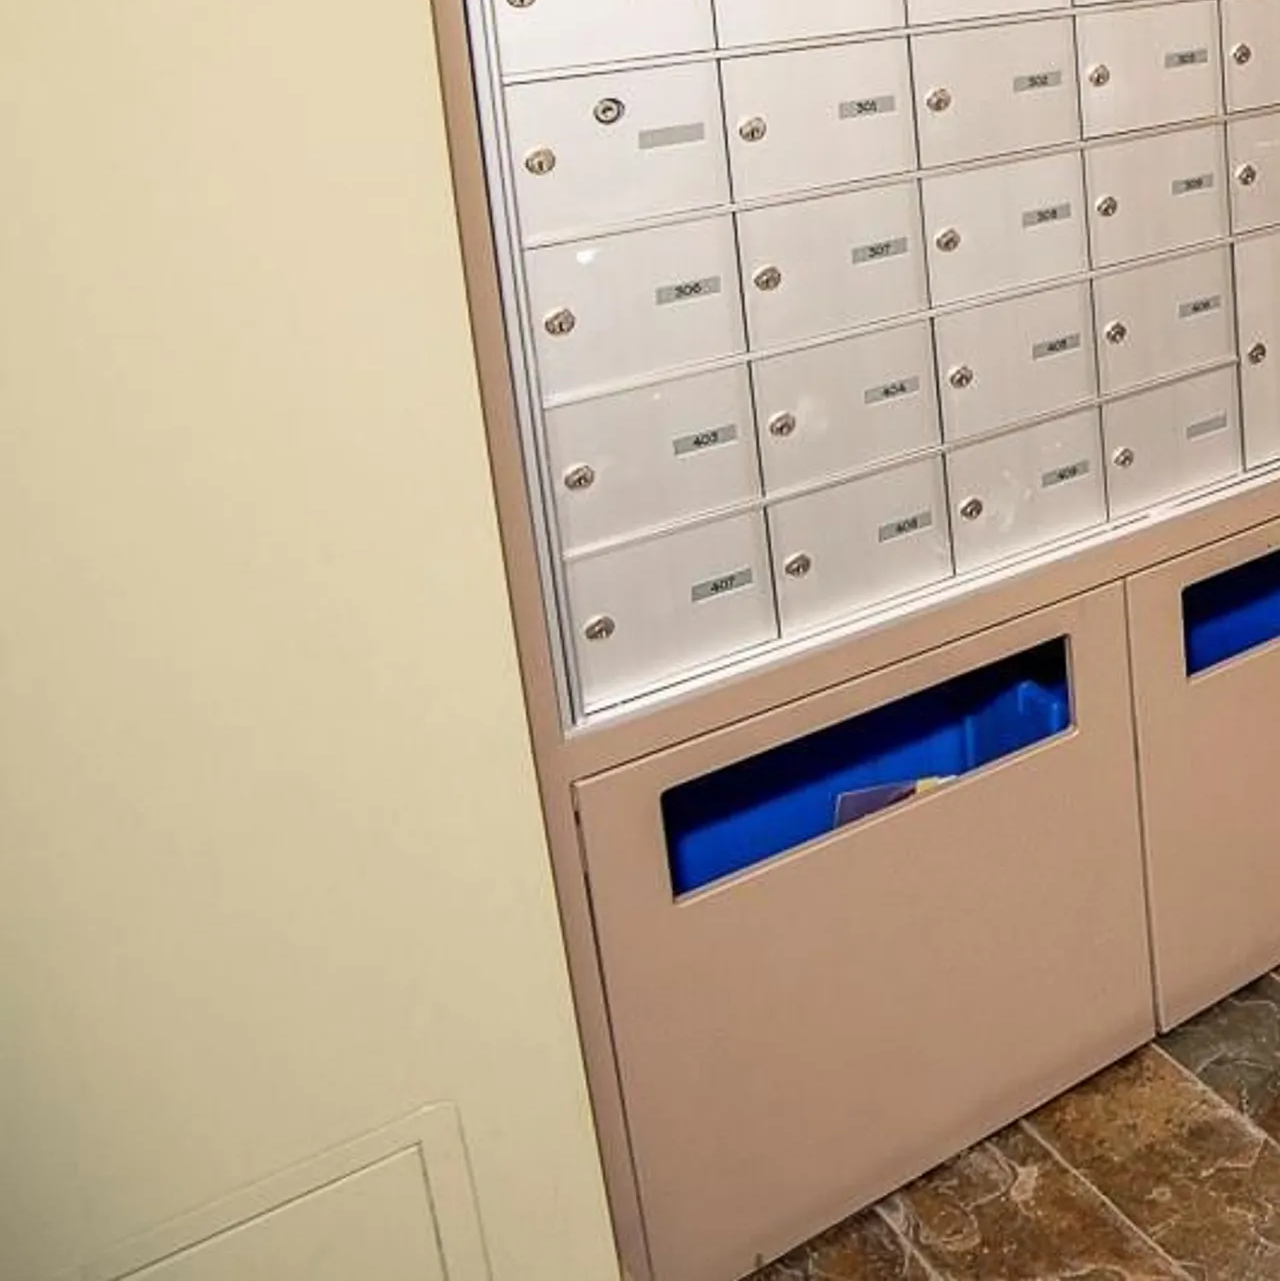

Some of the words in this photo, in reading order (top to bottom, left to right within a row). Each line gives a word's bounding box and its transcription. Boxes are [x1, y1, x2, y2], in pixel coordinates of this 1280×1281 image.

[856, 100, 878, 114] 301
[868, 243, 891, 258] 307
[674, 282, 702, 298] 306
[693, 430, 718, 446] 403
[710, 574, 735, 592] 407
